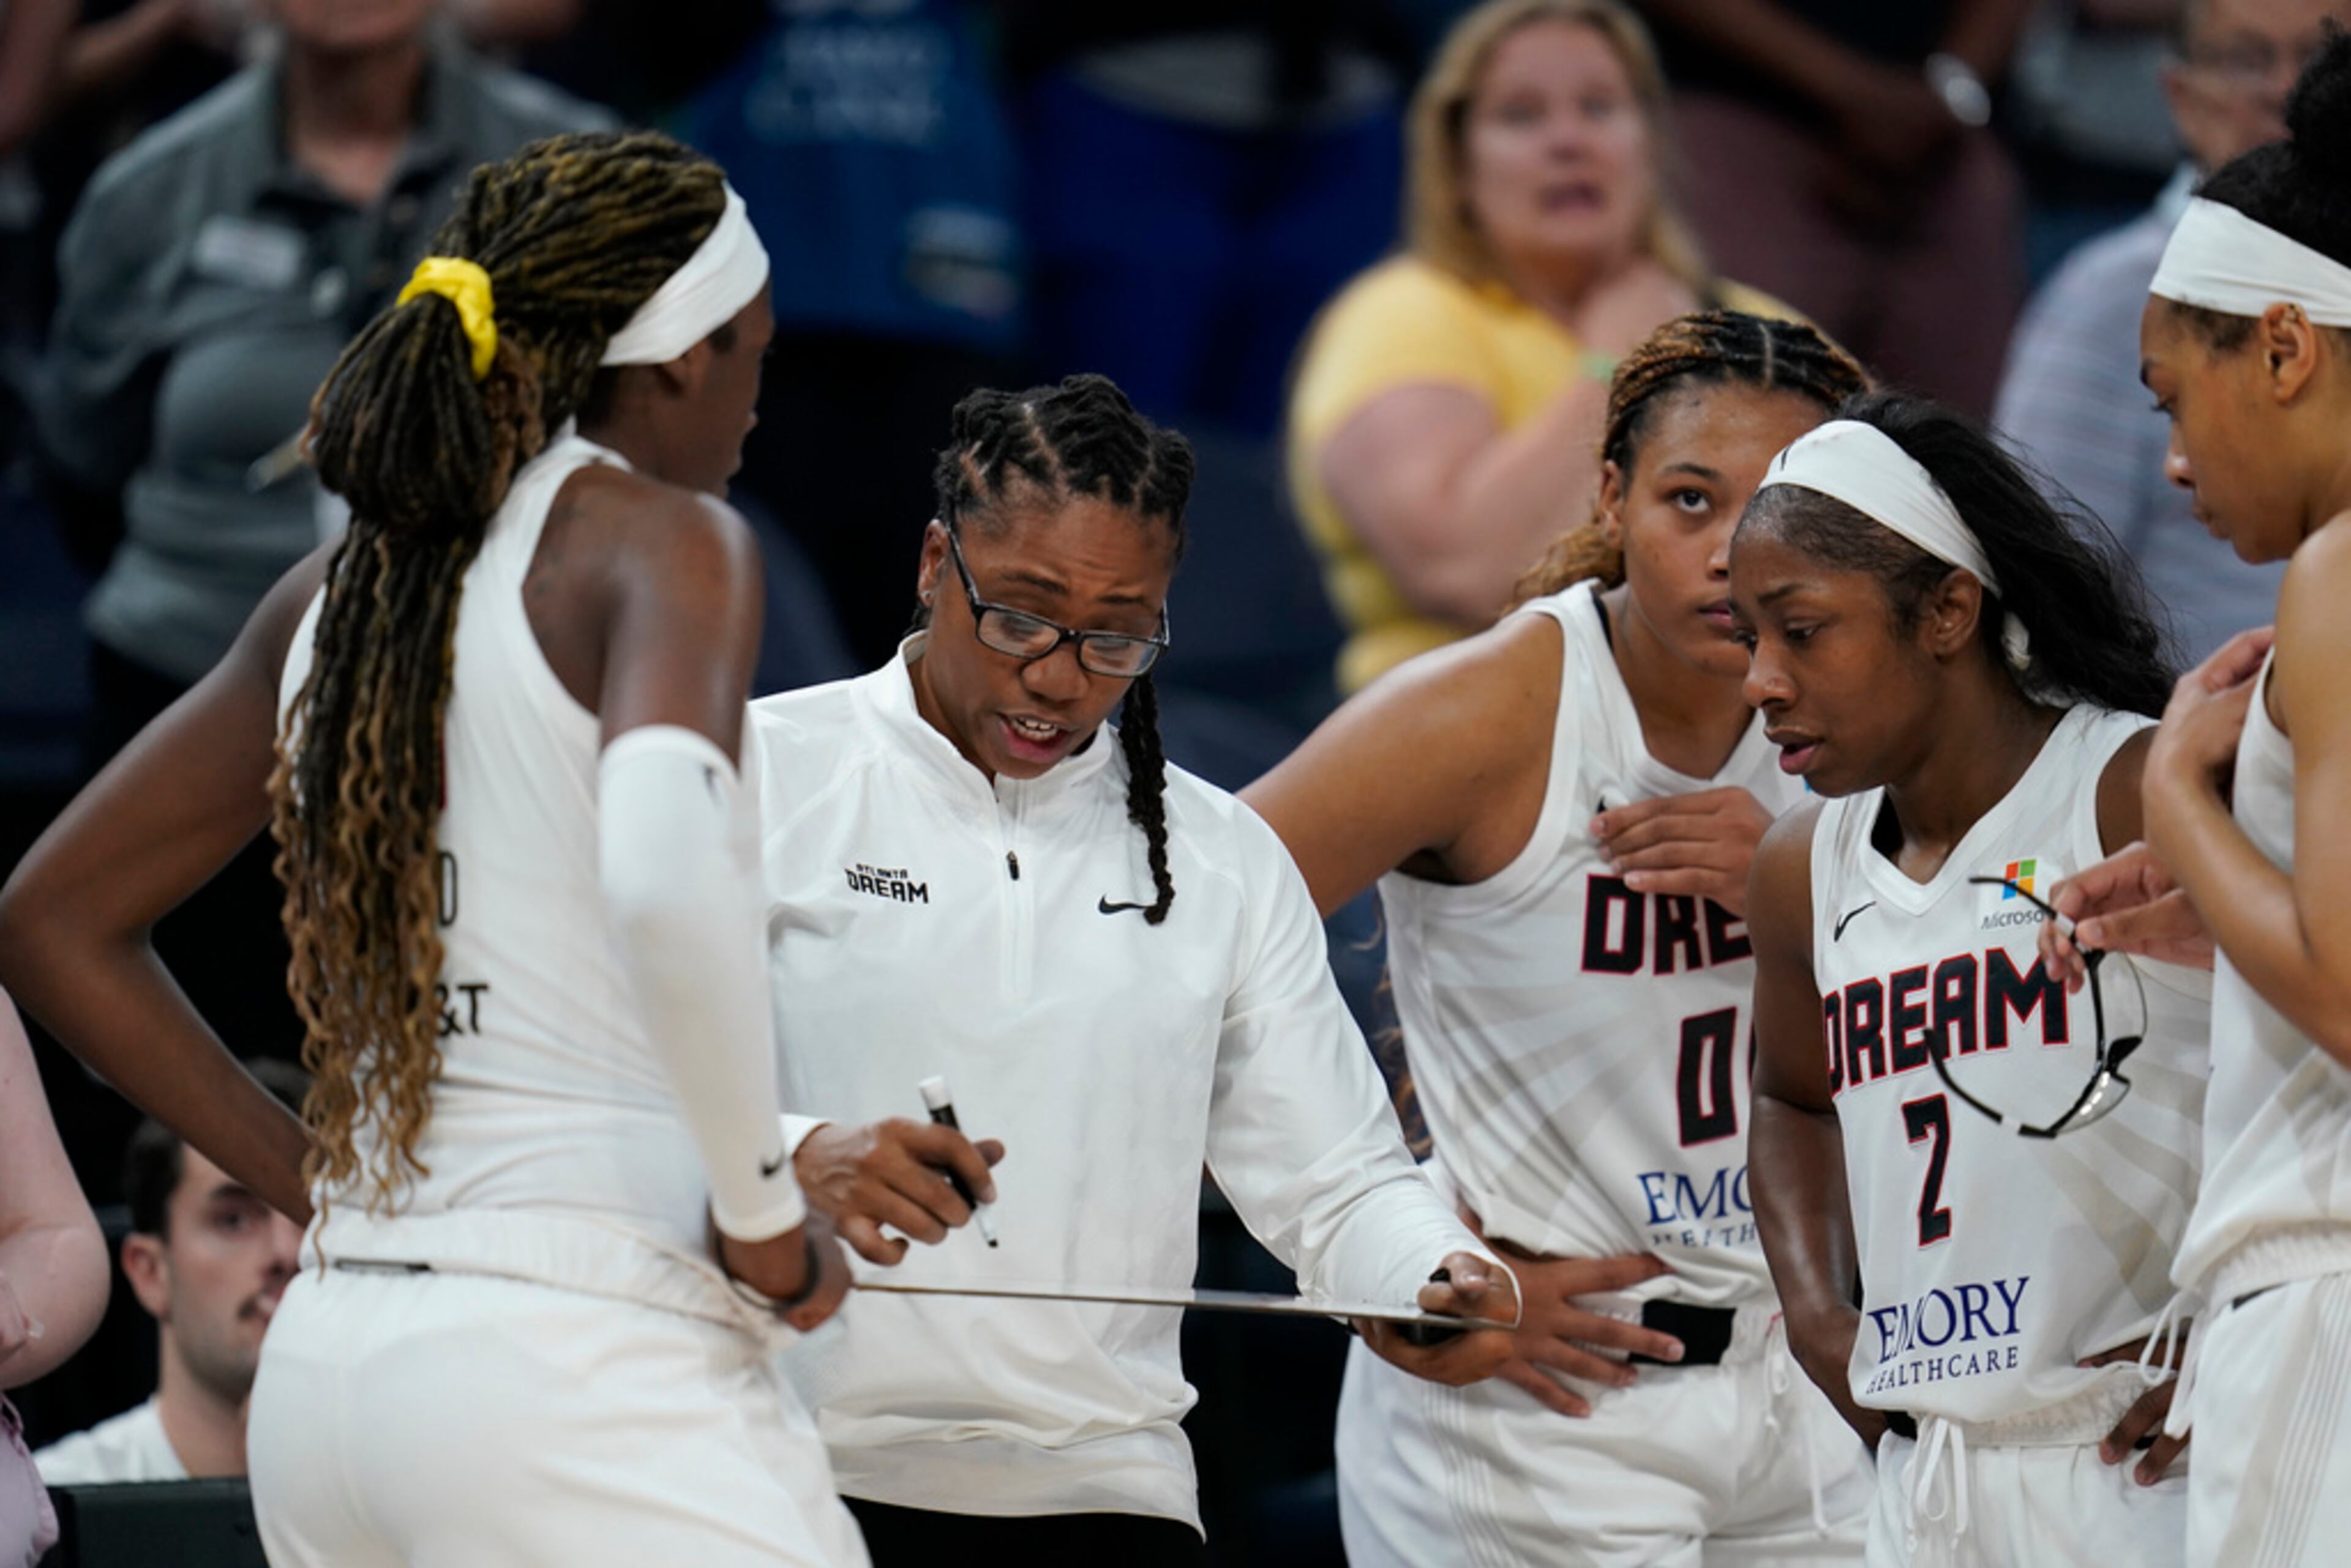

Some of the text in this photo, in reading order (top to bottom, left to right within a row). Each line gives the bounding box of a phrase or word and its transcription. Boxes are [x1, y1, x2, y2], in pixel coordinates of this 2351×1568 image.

[845, 868, 929, 904] DREAM
[1581, 874, 1753, 975] DRE
[1981, 908, 2044, 930] Microso
[435, 982, 488, 1038] &T
[1823, 947, 2069, 1098] DREAM
[1676, 1005, 1757, 1147] 0
[1902, 1093, 1952, 1246] 2
[1867, 1276, 2030, 1364] EMORY
